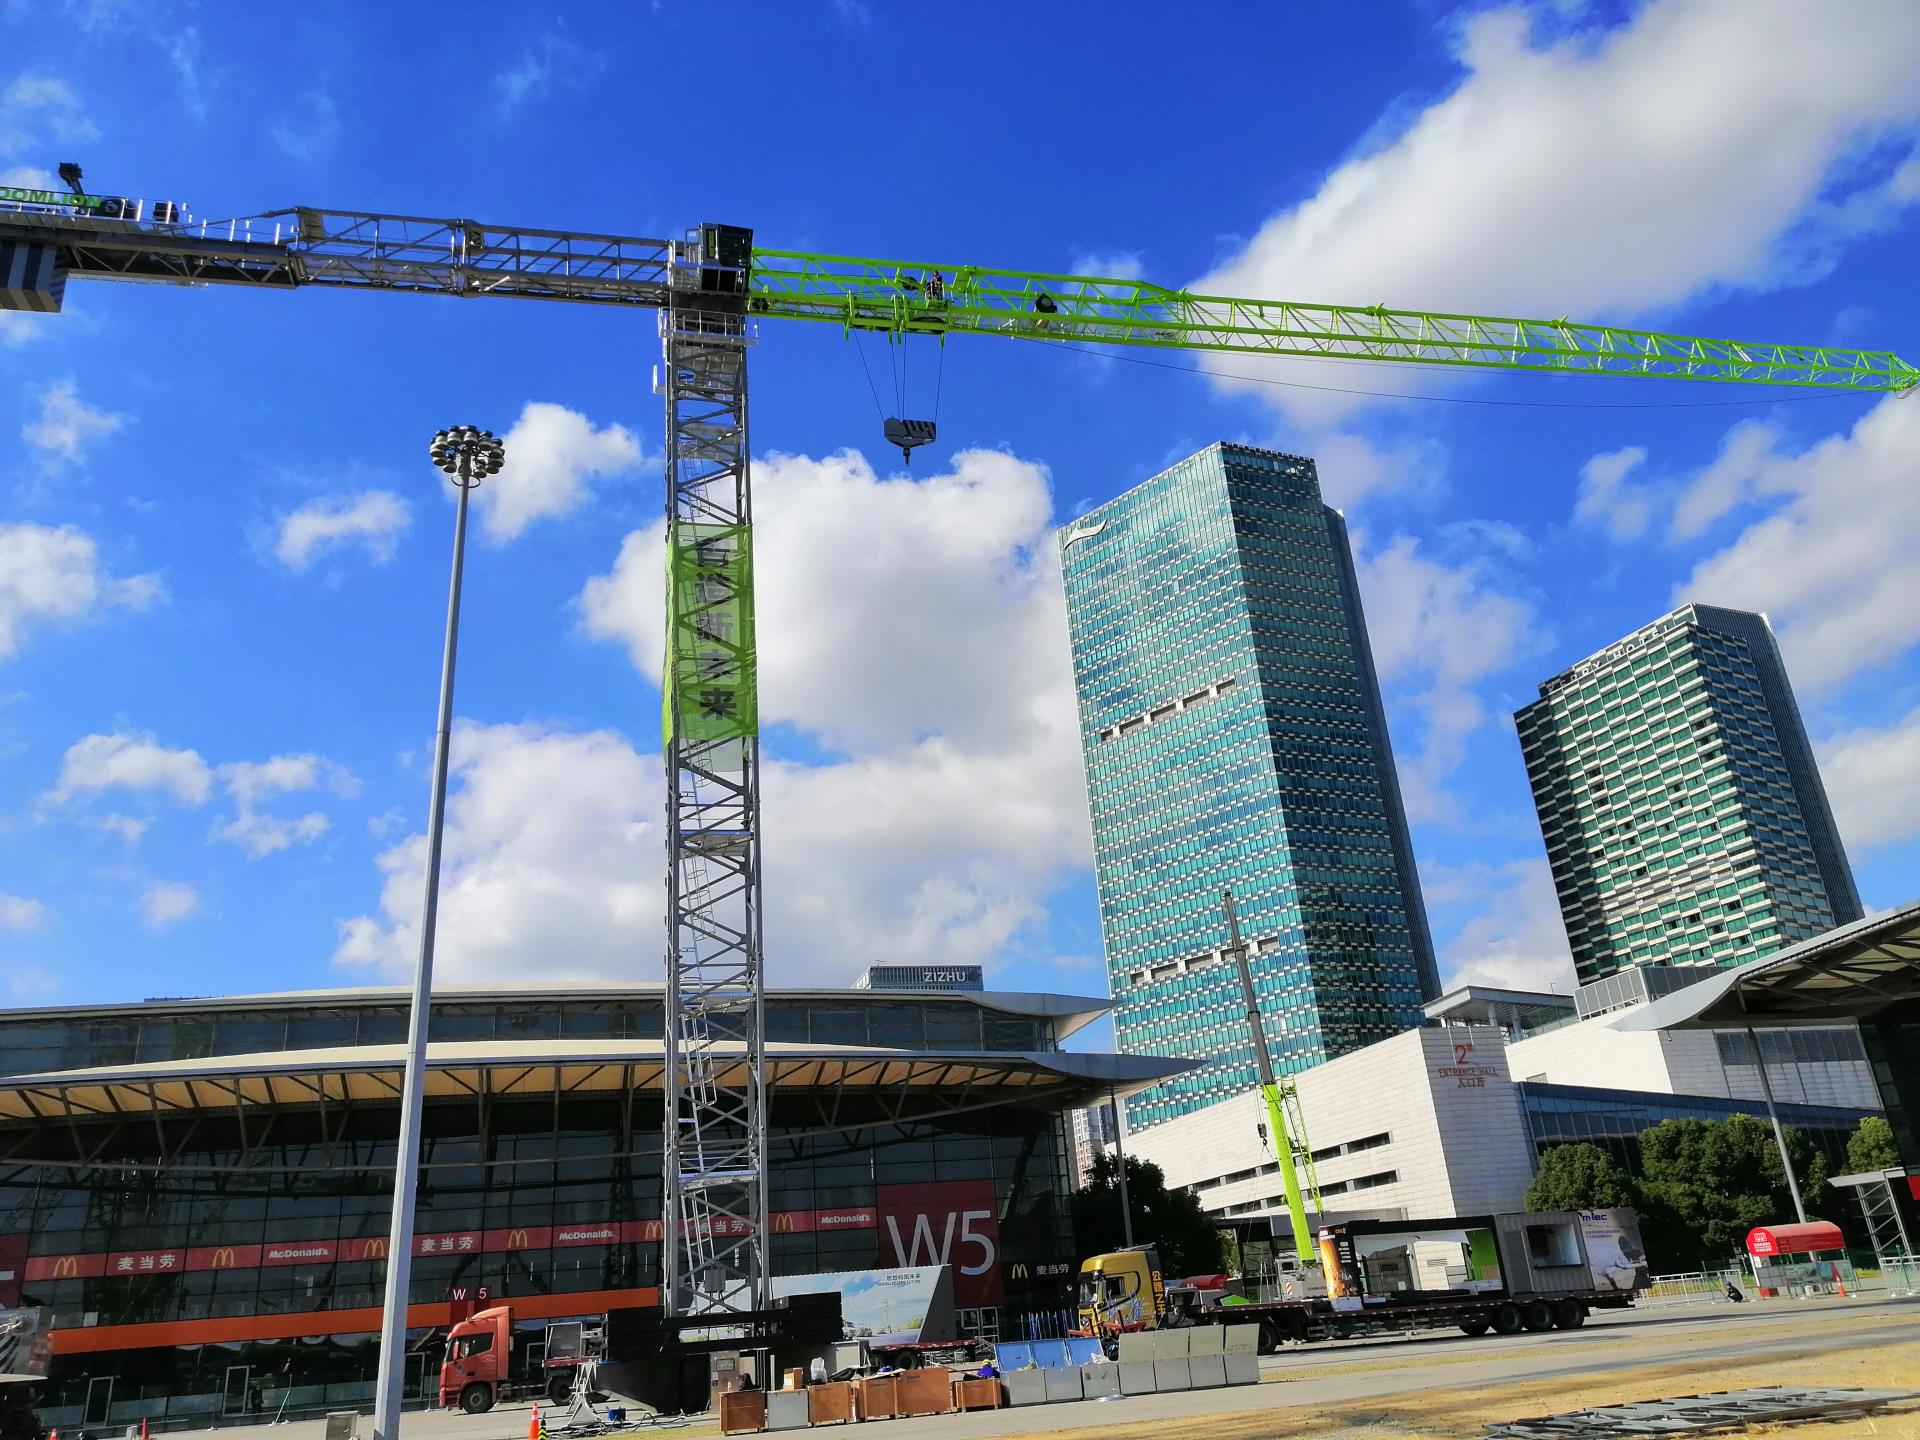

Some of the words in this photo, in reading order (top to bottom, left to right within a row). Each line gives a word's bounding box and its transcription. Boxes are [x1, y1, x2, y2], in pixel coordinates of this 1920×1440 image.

[924, 971, 966, 982] ZIZHU
[1439, 1066, 1477, 1078] ENTRANCE
[1478, 1065, 1498, 1077] HALL
[821, 1213, 871, 1225] McDonald's
[558, 1229, 614, 1241] McDonald's
[421, 1236, 474, 1253] 麦当劳
[886, 1209, 996, 1276] W5
[268, 1247, 329, 1260] McDonald's
[117, 1254, 176, 1271] 麦当劳
[1036, 1263, 1070, 1276] 麦当劳
[453, 1288, 467, 1301] W
[479, 1287, 487, 1300] 5
[1151, 1270, 1167, 1315] 公路之王
